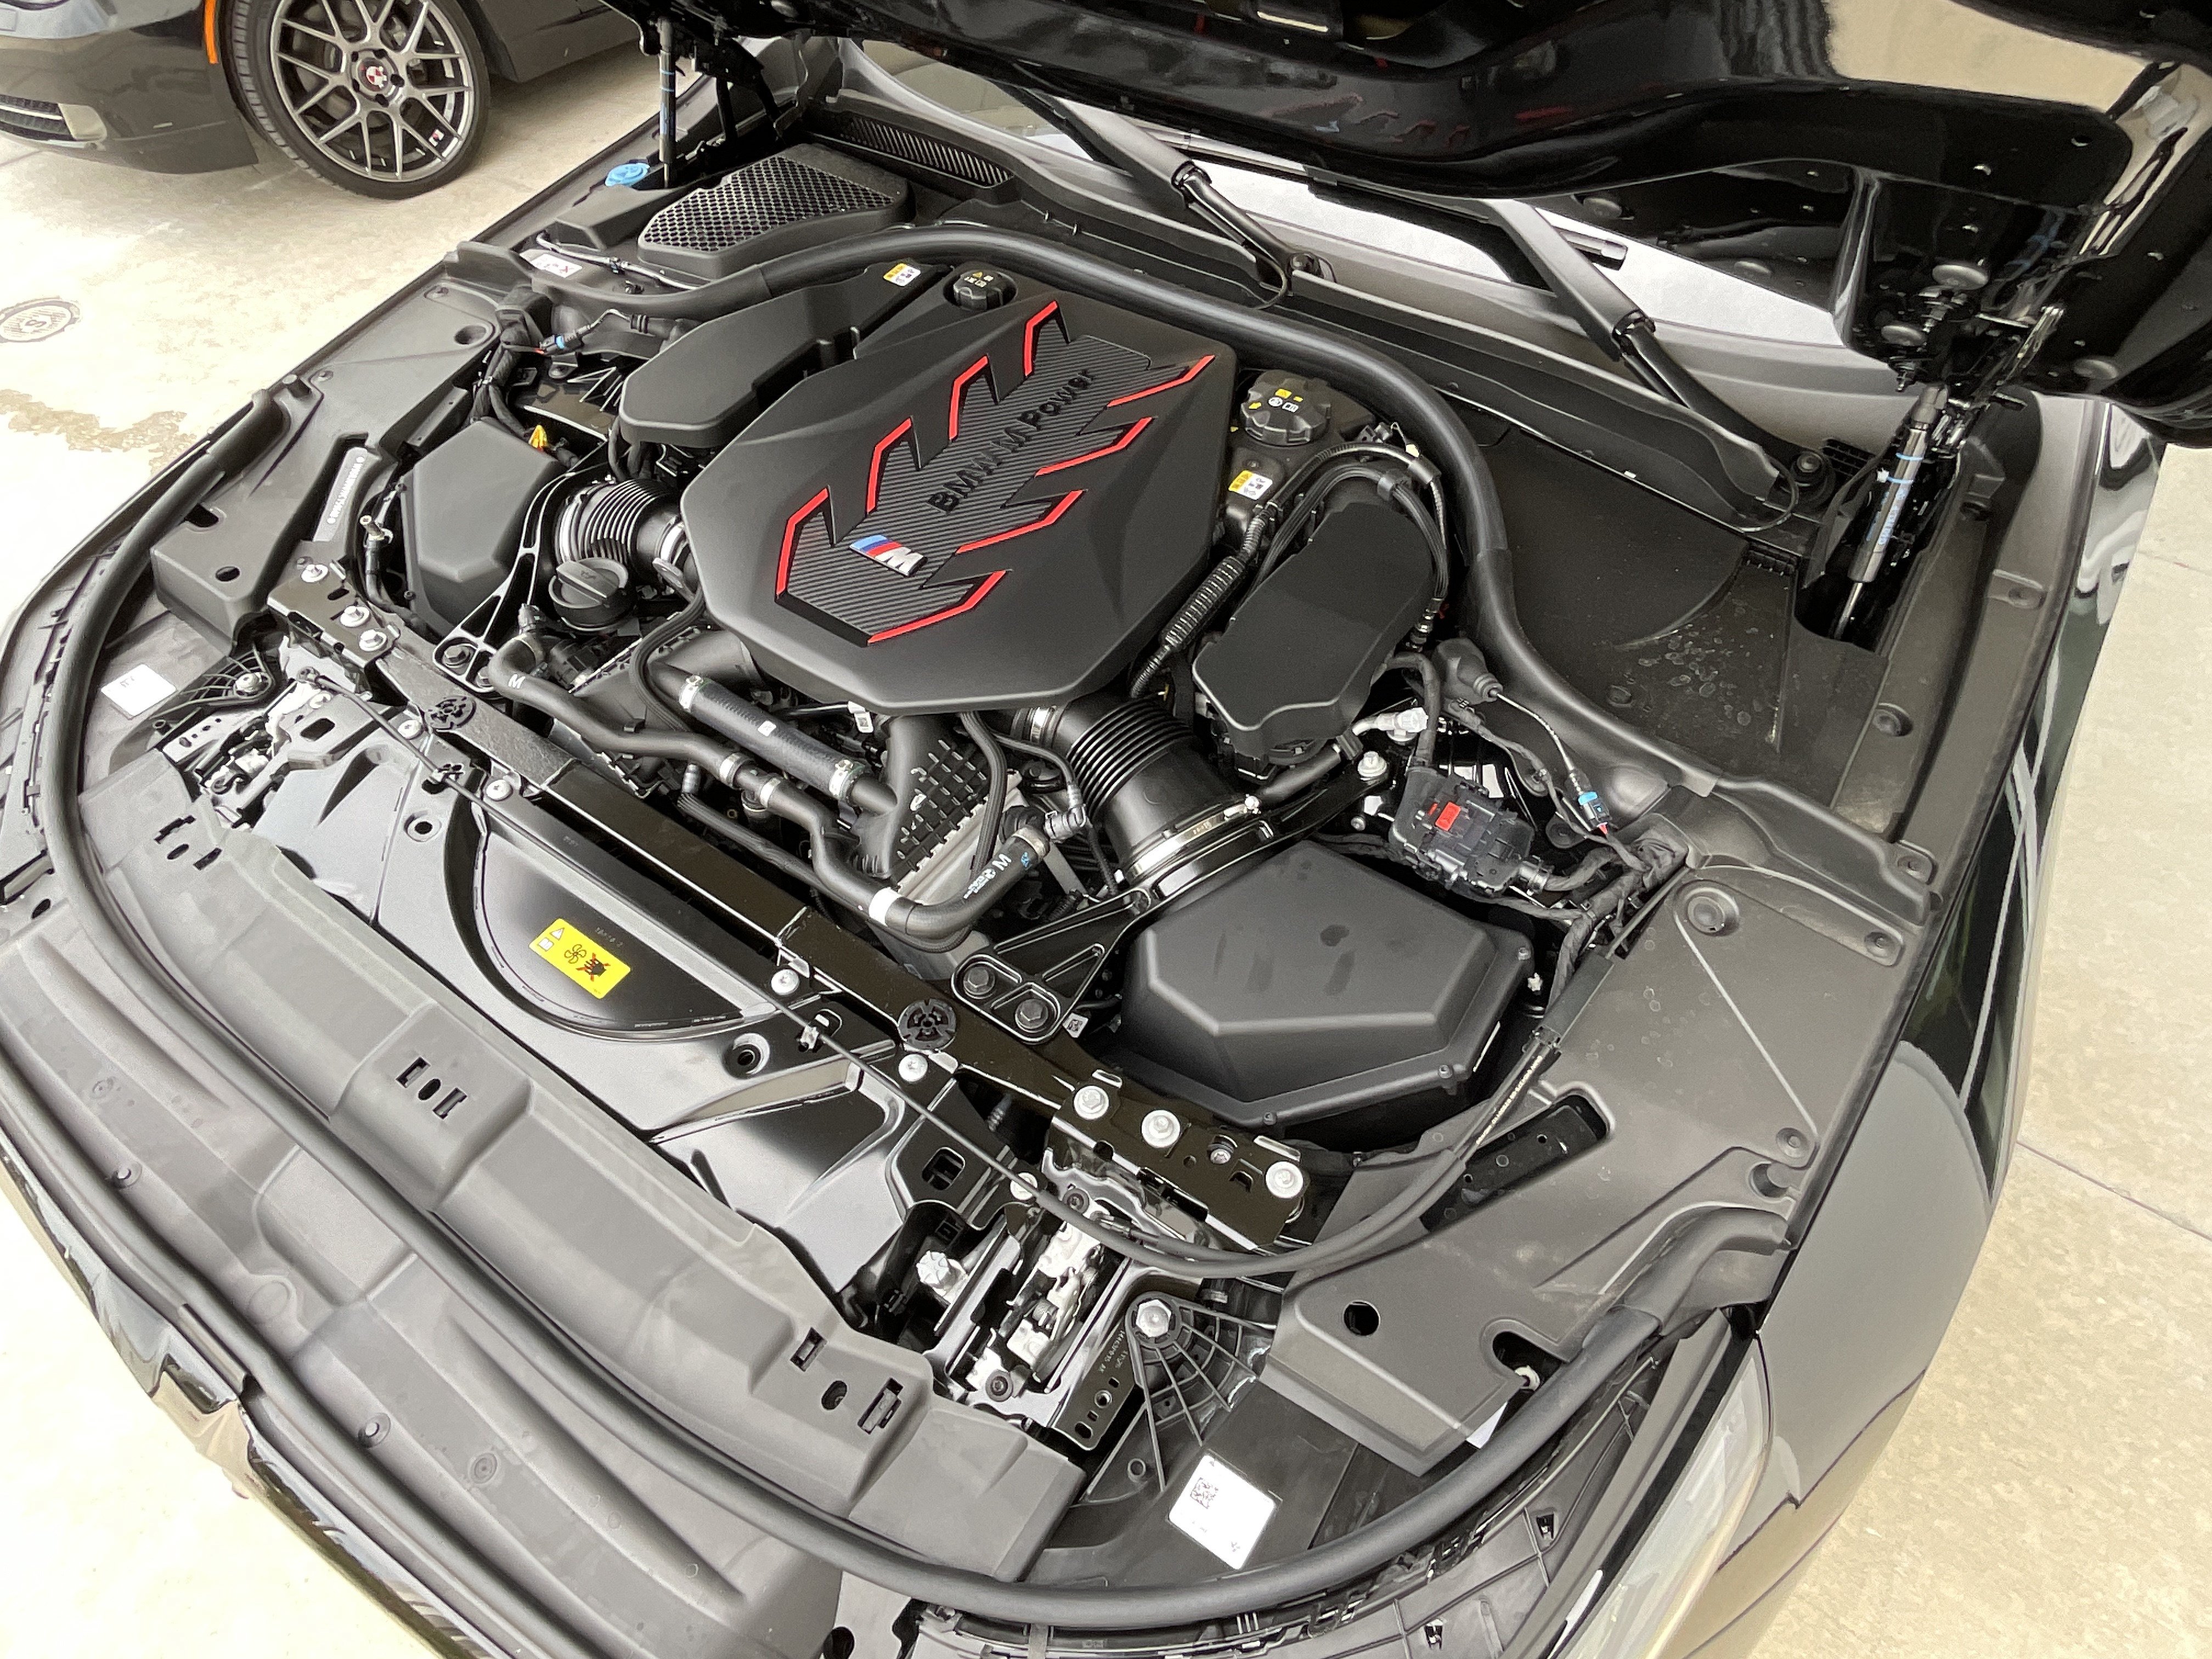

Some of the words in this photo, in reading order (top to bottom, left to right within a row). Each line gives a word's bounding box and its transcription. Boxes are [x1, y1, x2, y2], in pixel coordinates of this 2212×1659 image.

[926, 450, 1003, 516] BMW
[989, 427, 1033, 453] M
[1017, 369, 1094, 431] Power
[508, 674, 526, 689] M
[992, 854, 1012, 871] M
